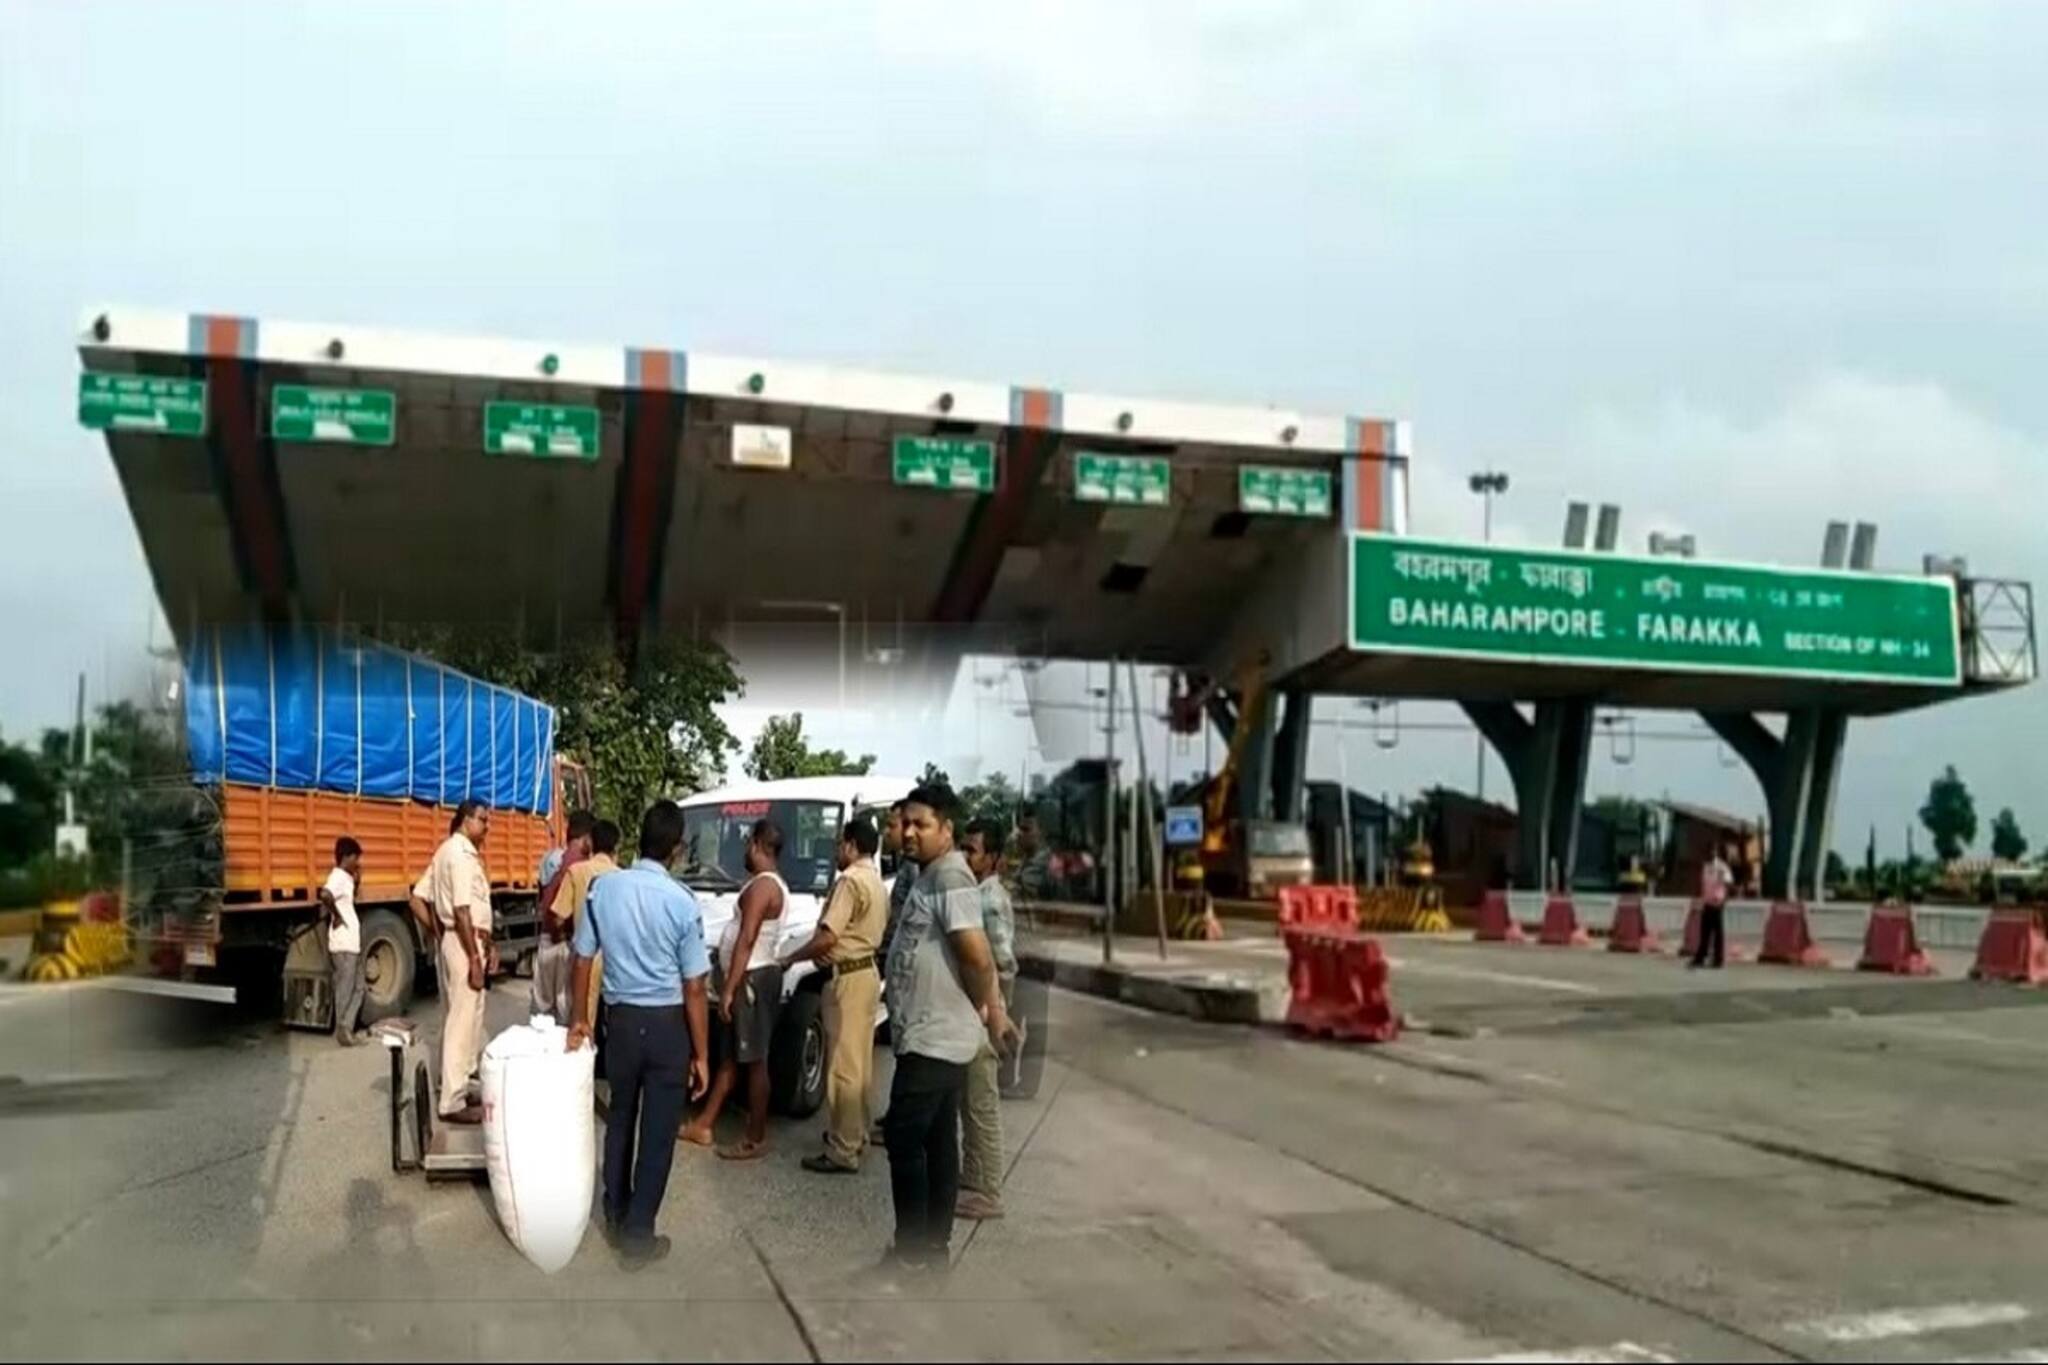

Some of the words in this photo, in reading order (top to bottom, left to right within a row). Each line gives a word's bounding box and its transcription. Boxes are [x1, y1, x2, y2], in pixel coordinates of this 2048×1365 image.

[1389, 597, 1606, 639] BAHARAMPORE
[1637, 612, 1762, 648] FARAKKA
[1784, 631, 1851, 654] SECTION
[1856, 636, 1875, 655] OF
[721, 801, 771, 817] POLICE
